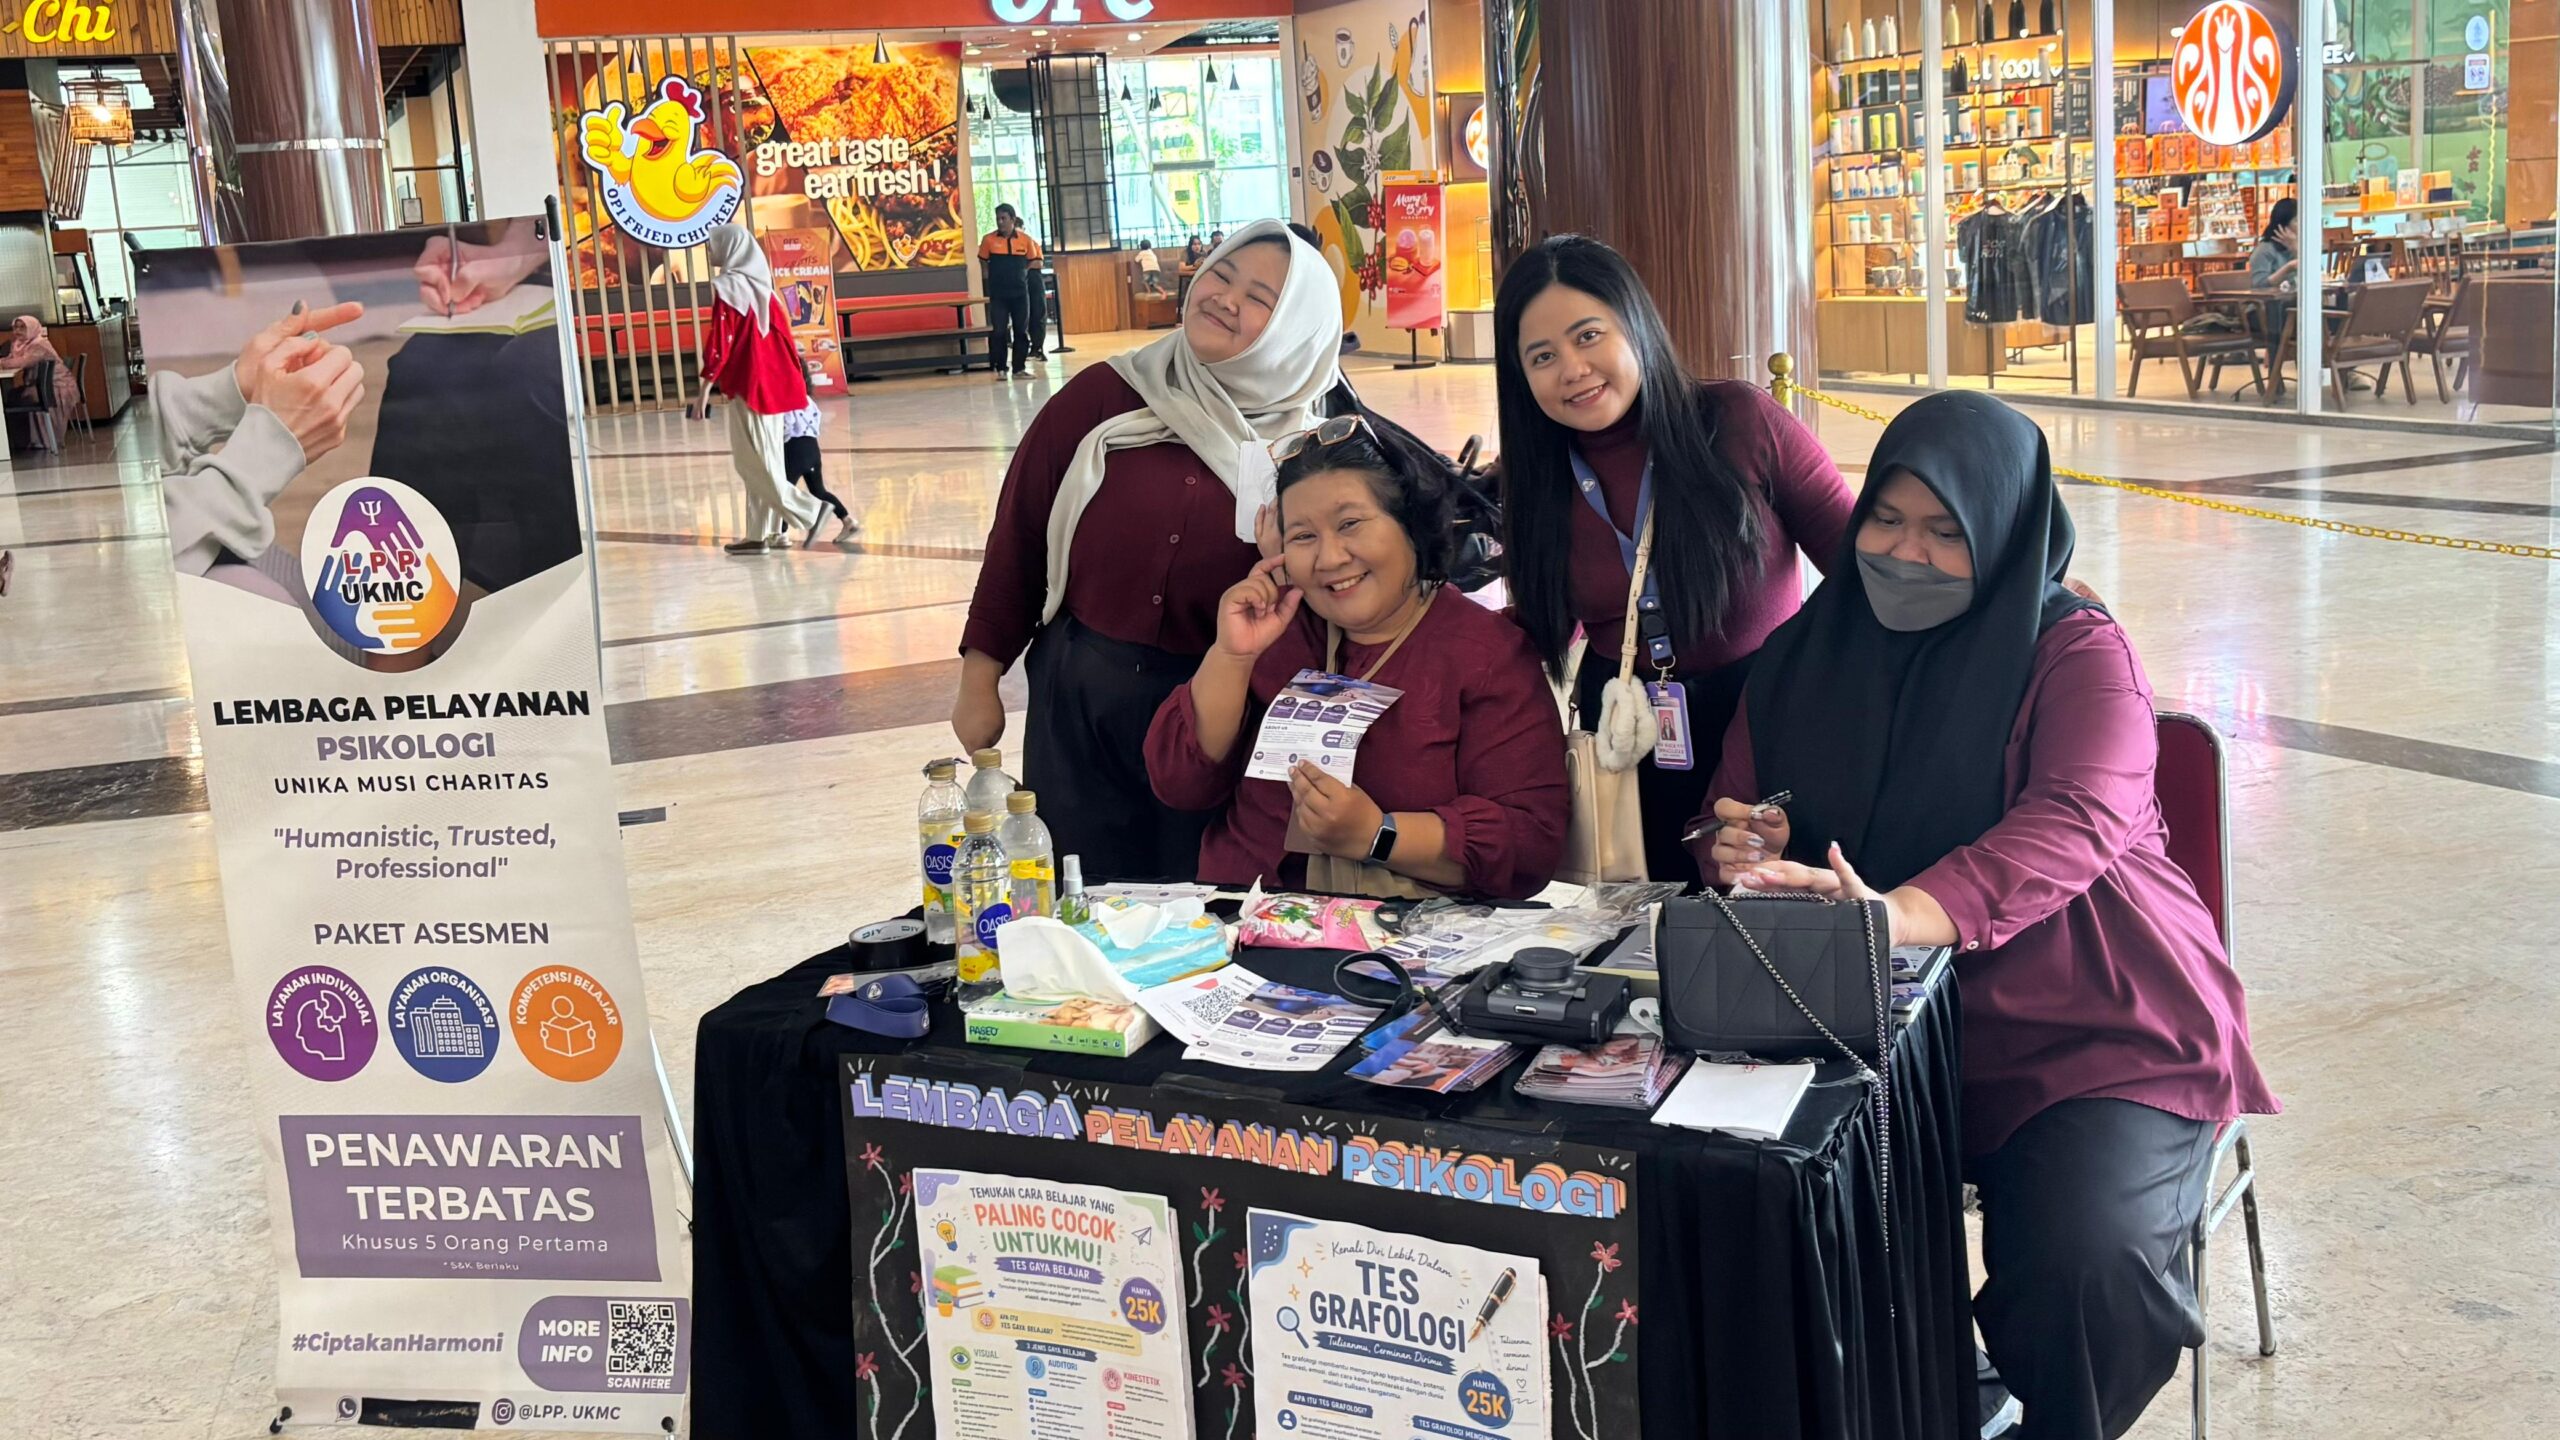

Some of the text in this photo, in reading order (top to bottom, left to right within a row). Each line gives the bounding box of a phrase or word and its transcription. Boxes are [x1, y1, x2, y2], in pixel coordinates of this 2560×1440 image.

[756, 133, 909, 176] great taste
[804, 169, 851, 200] eat
[607, 188, 737, 244] OPI FRIED CHICKEN
[775, 265, 829, 277] ICE CREAM
[341, 580, 424, 604] UKMC
[213, 690, 590, 726] LEMBAGA PELAYANAN
[317, 732, 496, 761] PSIKOLOGI
[274, 772, 550, 794] UNIKA MUSI CHARITAS
[274, 823, 557, 851] "Humanistic, Trusted,
[336, 856, 508, 879] Professional"
[925, 855, 954, 871] OASIS
[314, 922, 550, 945] PAKET ASESMEN
[272, 973, 372, 1027] LAYANAN INDIVIDUAL
[395, 971, 496, 1029] LAYANAN ORGANISASI
[516, 971, 619, 1026] KOMPETENSI BELAJAR
[850, 1072, 1627, 1219] LEMBAGA PELAYANAN PSIKOLOGI
[347, 1186, 595, 1223] TERBATAS
[969, 1187, 1115, 1214] TEMUKAN CARA BELAJAR YANG
[974, 1203, 1117, 1243] PALING COCOK
[342, 1233, 609, 1254] Khusus 5 Orang Pertama
[992, 1231, 1102, 1265] UNTUKMU!
[1010, 1260, 1090, 1279] TES GAYA BELAJAR
[1331, 1240, 1453, 1278] Kenali Diri Lebih Dalam
[1130, 1286, 1151, 1296] HANYA
[1355, 1259, 1420, 1305] TES
[1125, 1296, 1161, 1324] 25K
[1309, 1290, 1466, 1353] GRAFOLOGI
[538, 1319, 601, 1337] MORE
[292, 1331, 504, 1356] #CiptakanHarmoni
[541, 1345, 593, 1363] INFO
[973, 1348, 1000, 1359] VISUAL
[1373, 1343, 1412, 1361] Cerminan
[1414, 1350, 1444, 1367] Dirimu
[1048, 1360, 1078, 1371] AUDITORI
[607, 1377, 672, 1390] SCAN HERE
[1124, 1372, 1160, 1386] KINESTETIK
[1472, 1379, 1496, 1391] HANYA
[519, 1404, 622, 1421] @LPP. UKMC
[1293, 1394, 1368, 1414] APA ITU TES GRAFOLOGI?
[1466, 1388, 1507, 1420] 25K
[1419, 1419, 1430, 1429] TES
[1431, 1422, 1465, 1437] GRAFOLOGI
